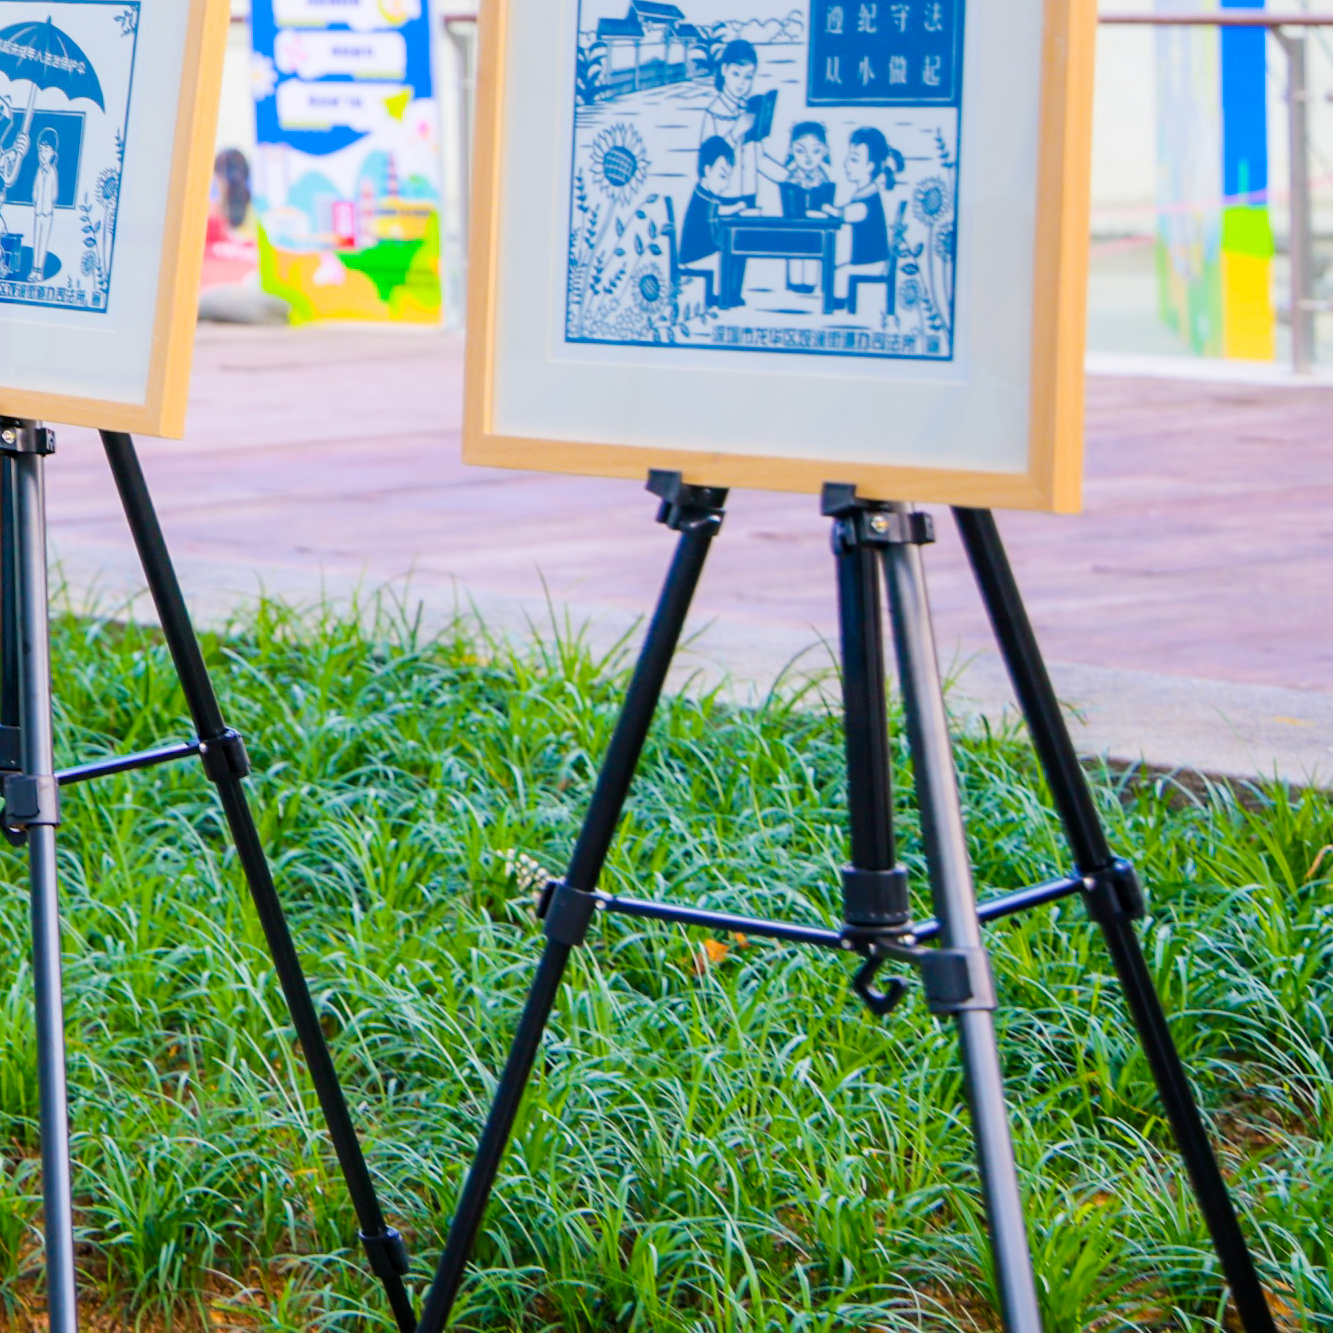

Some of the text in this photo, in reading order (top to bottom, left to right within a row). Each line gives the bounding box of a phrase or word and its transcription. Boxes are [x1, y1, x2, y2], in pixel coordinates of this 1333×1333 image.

[825, 2, 943, 34] 遵纪守法
[826, 55, 941, 86] 从小做起
